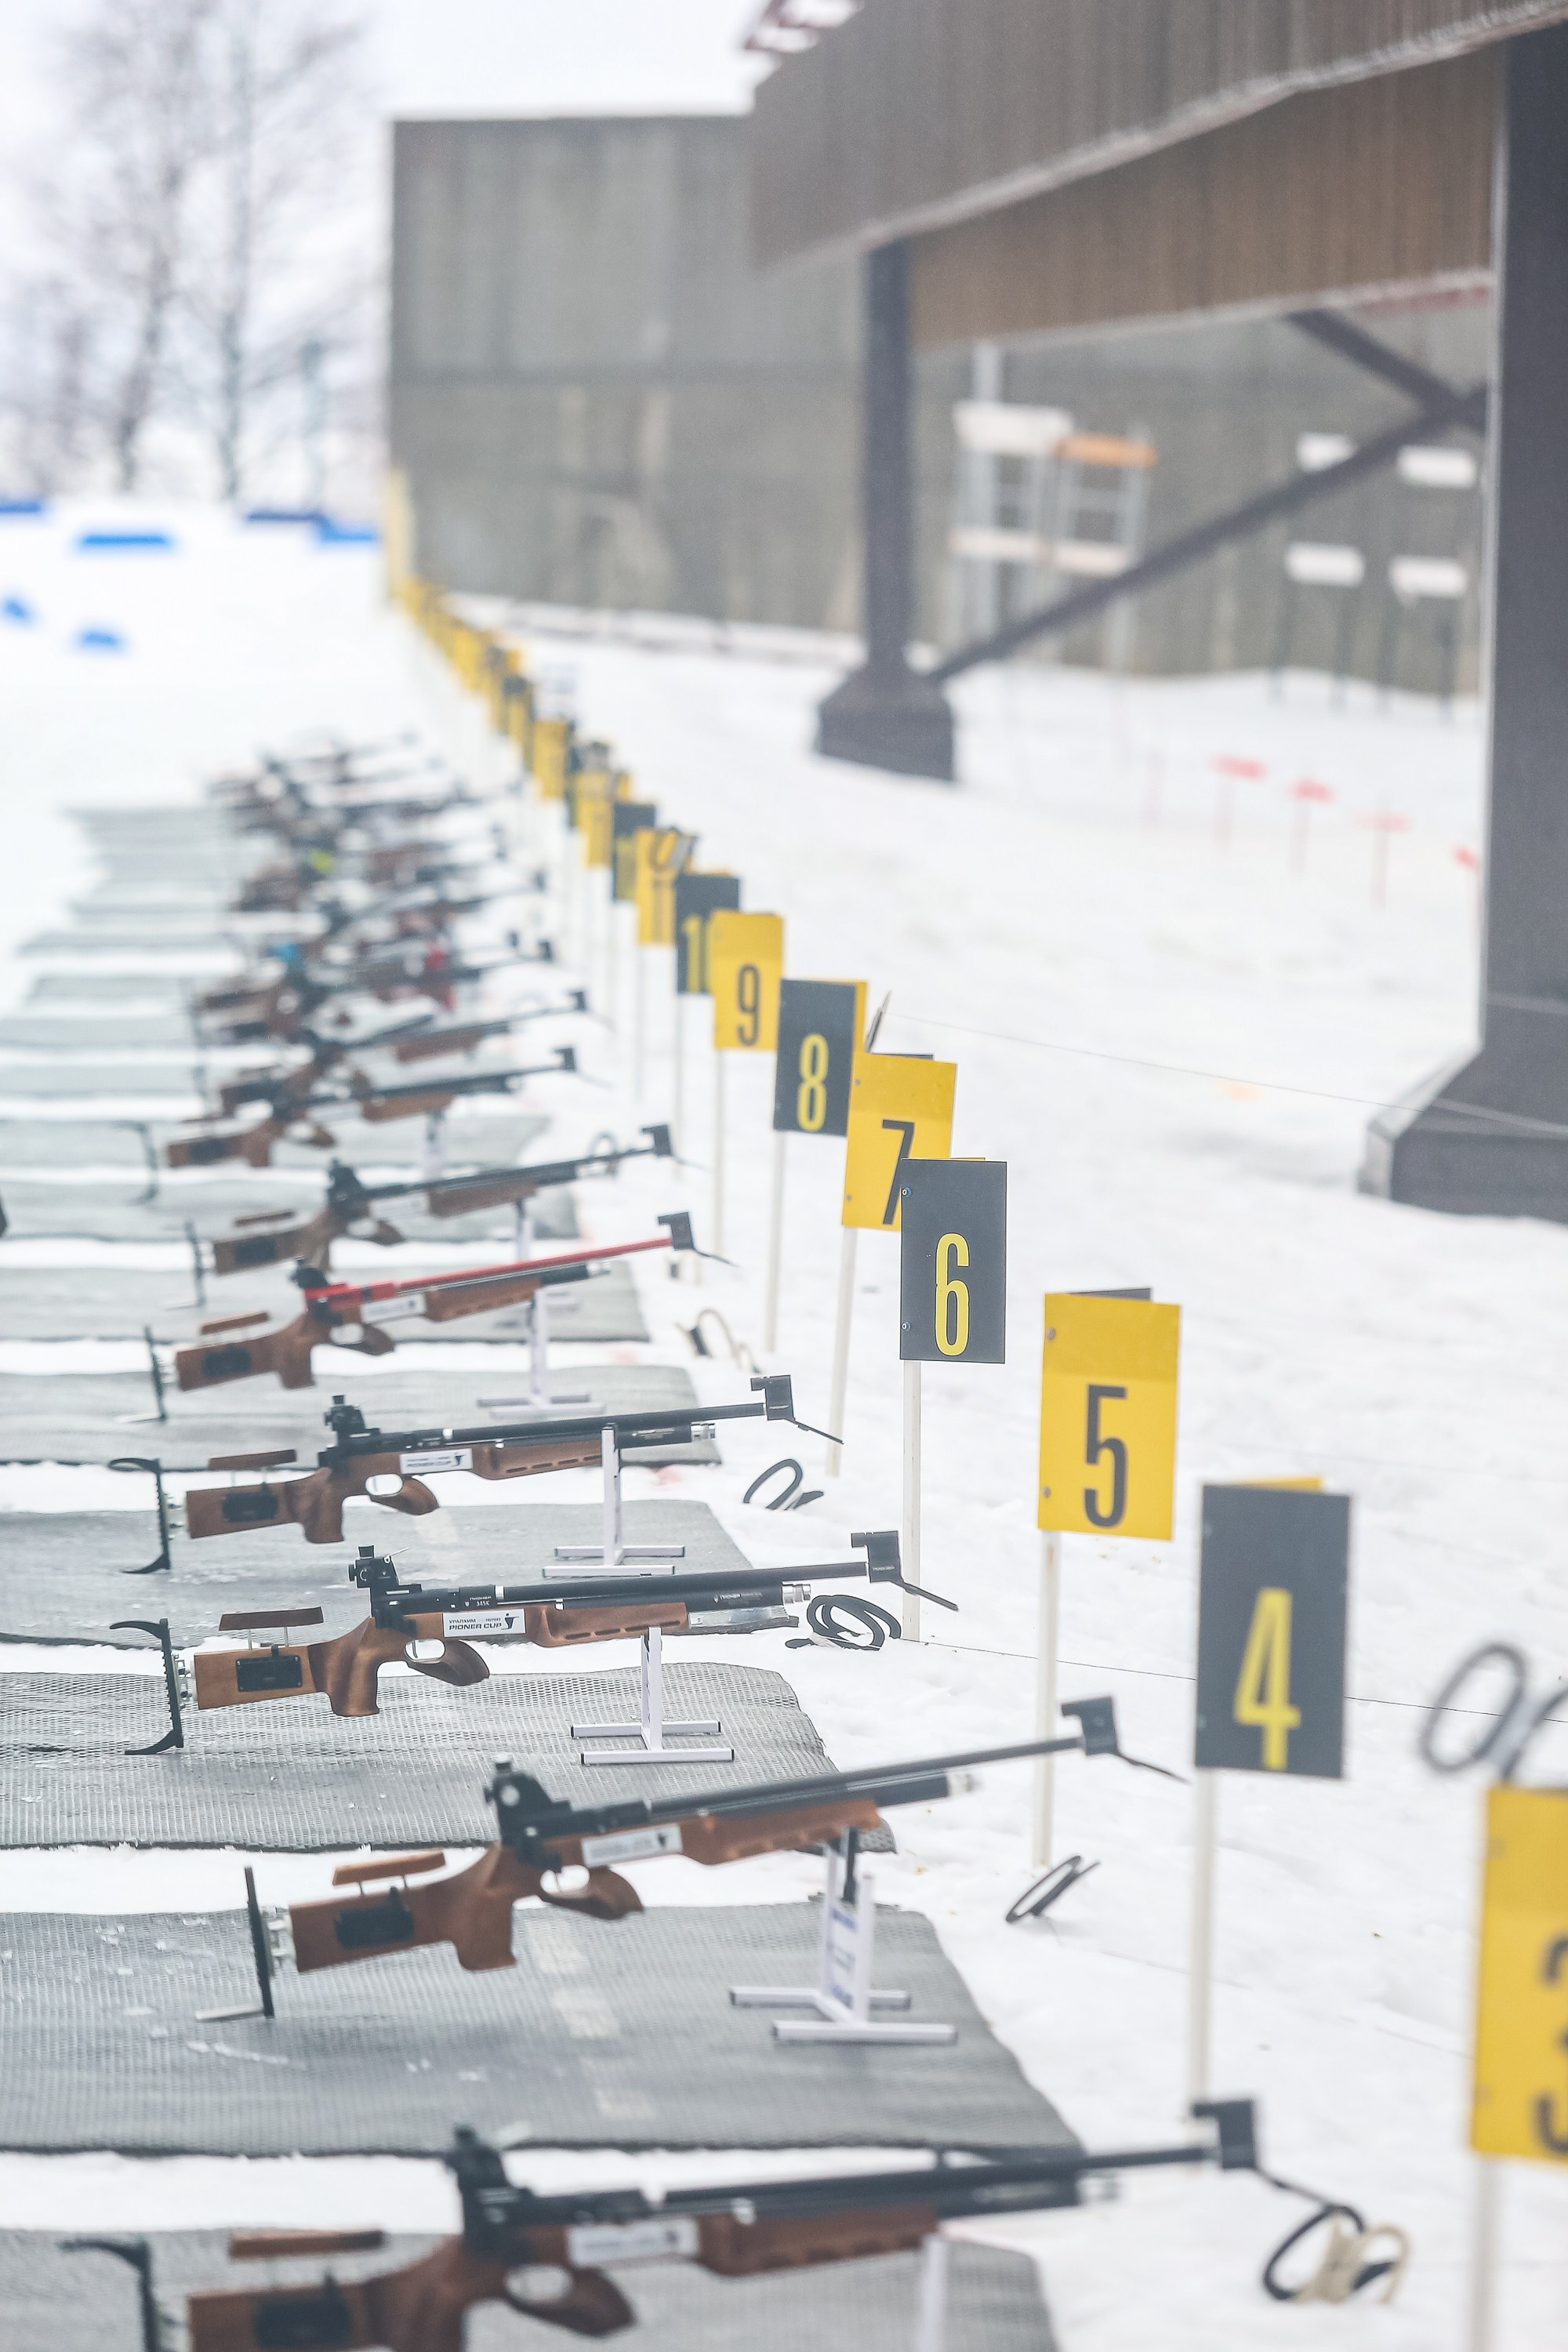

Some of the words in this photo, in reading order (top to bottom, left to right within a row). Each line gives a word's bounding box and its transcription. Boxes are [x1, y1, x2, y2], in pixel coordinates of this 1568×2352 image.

[736, 963, 760, 1047] 9
[797, 1033, 829, 1132] 8
[882, 1119, 915, 1225] 7
[934, 1233, 970, 1356] 6
[1083, 1383, 1127, 1527] 5
[1233, 1587, 1301, 1771] 4
